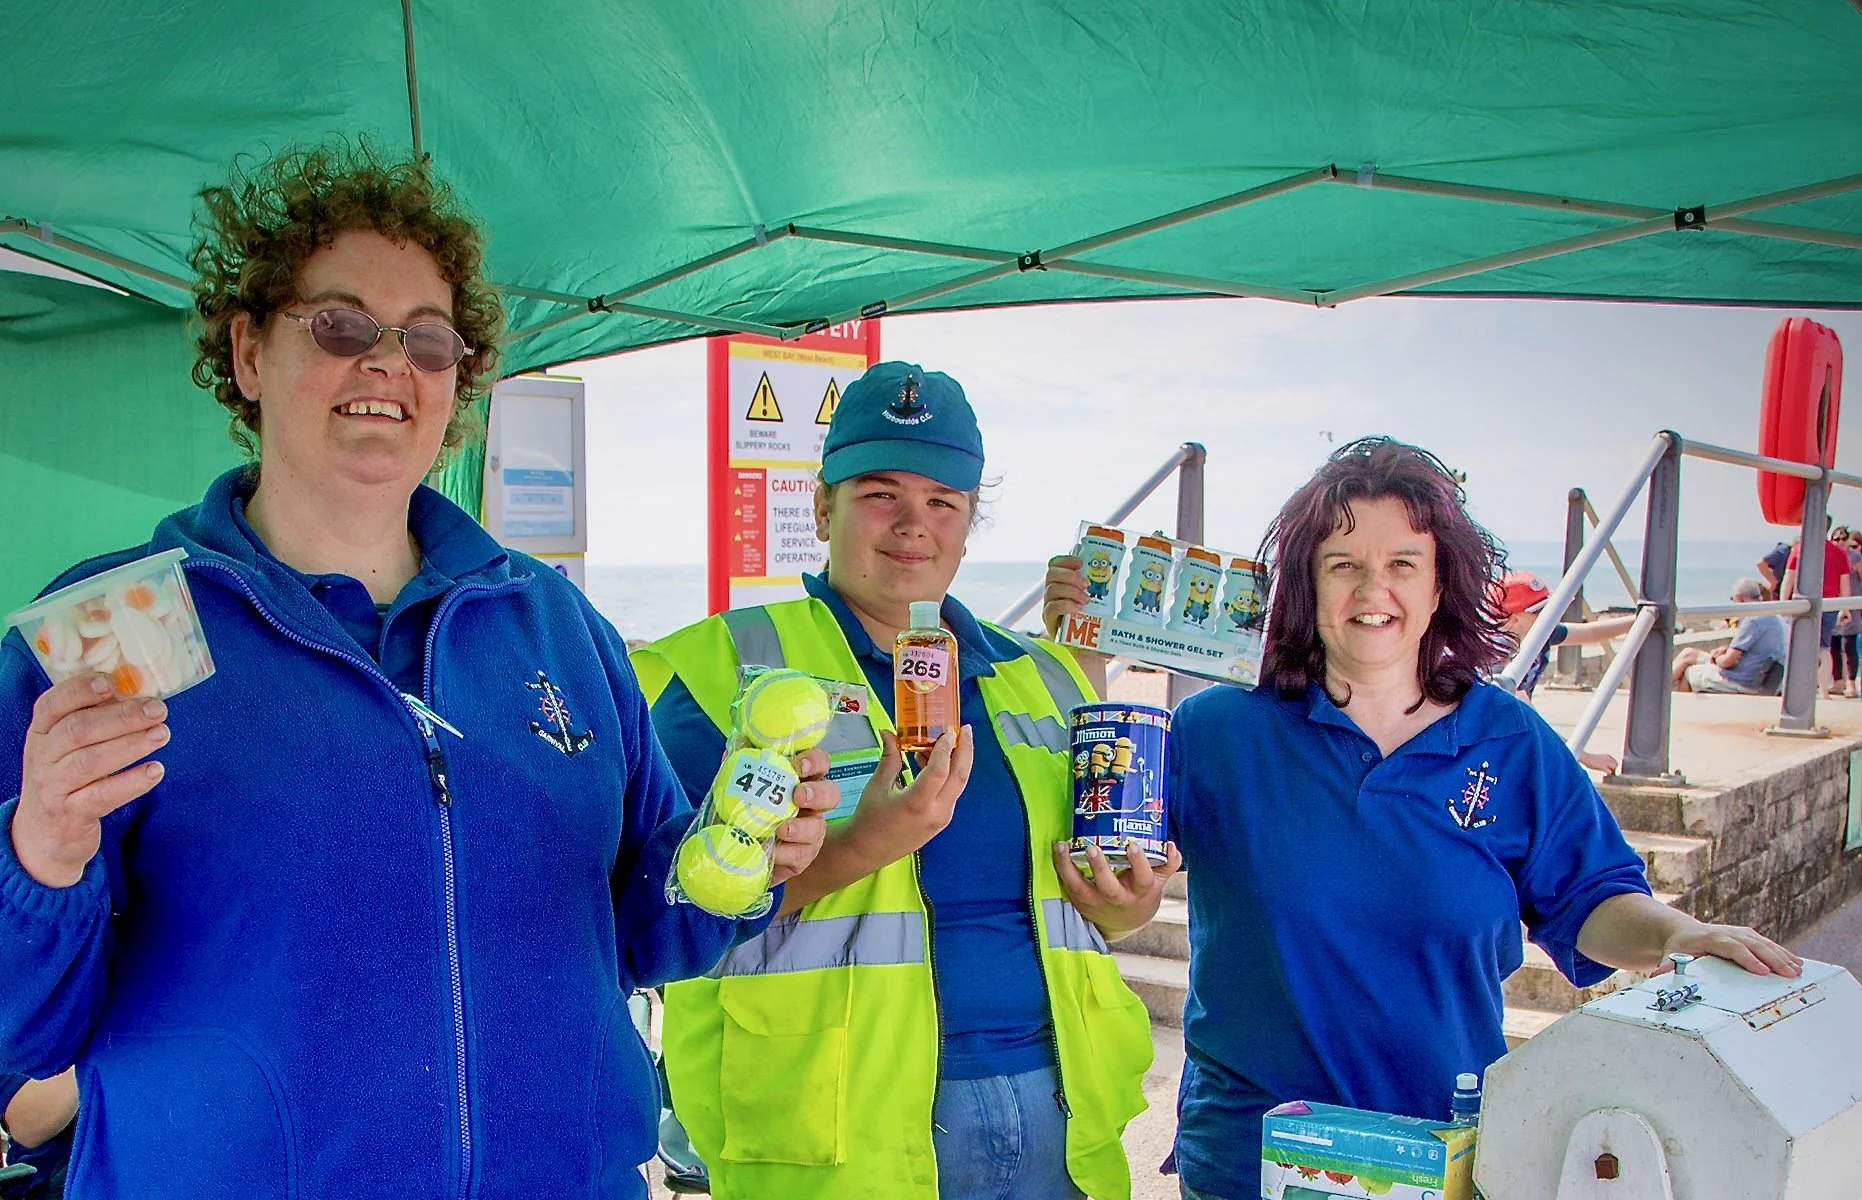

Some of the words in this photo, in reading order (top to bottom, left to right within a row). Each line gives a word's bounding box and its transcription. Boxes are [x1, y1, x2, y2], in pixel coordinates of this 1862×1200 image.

[750, 430, 776, 438] BEWARE
[736, 441, 766, 450] SLIPPERY
[768, 442, 790, 451] ROCKS
[772, 480, 816, 492] CAUTIO
[773, 507, 799, 517] THERE
[802, 508, 810, 517] IS
[775, 523, 815, 533] LIFEGUAR
[781, 538, 815, 548] SERVICE
[775, 553, 822, 563] OPERATING
[1066, 619, 1101, 648] ME
[1111, 629, 1136, 640] BATH
[1145, 636, 1185, 650] SHOWER
[1187, 645, 1204, 655] GEL
[1206, 649, 1224, 658] SET
[901, 659, 941, 678] 265
[736, 772, 786, 805] 475
[1412, 1175, 1438, 1187] Fresh
